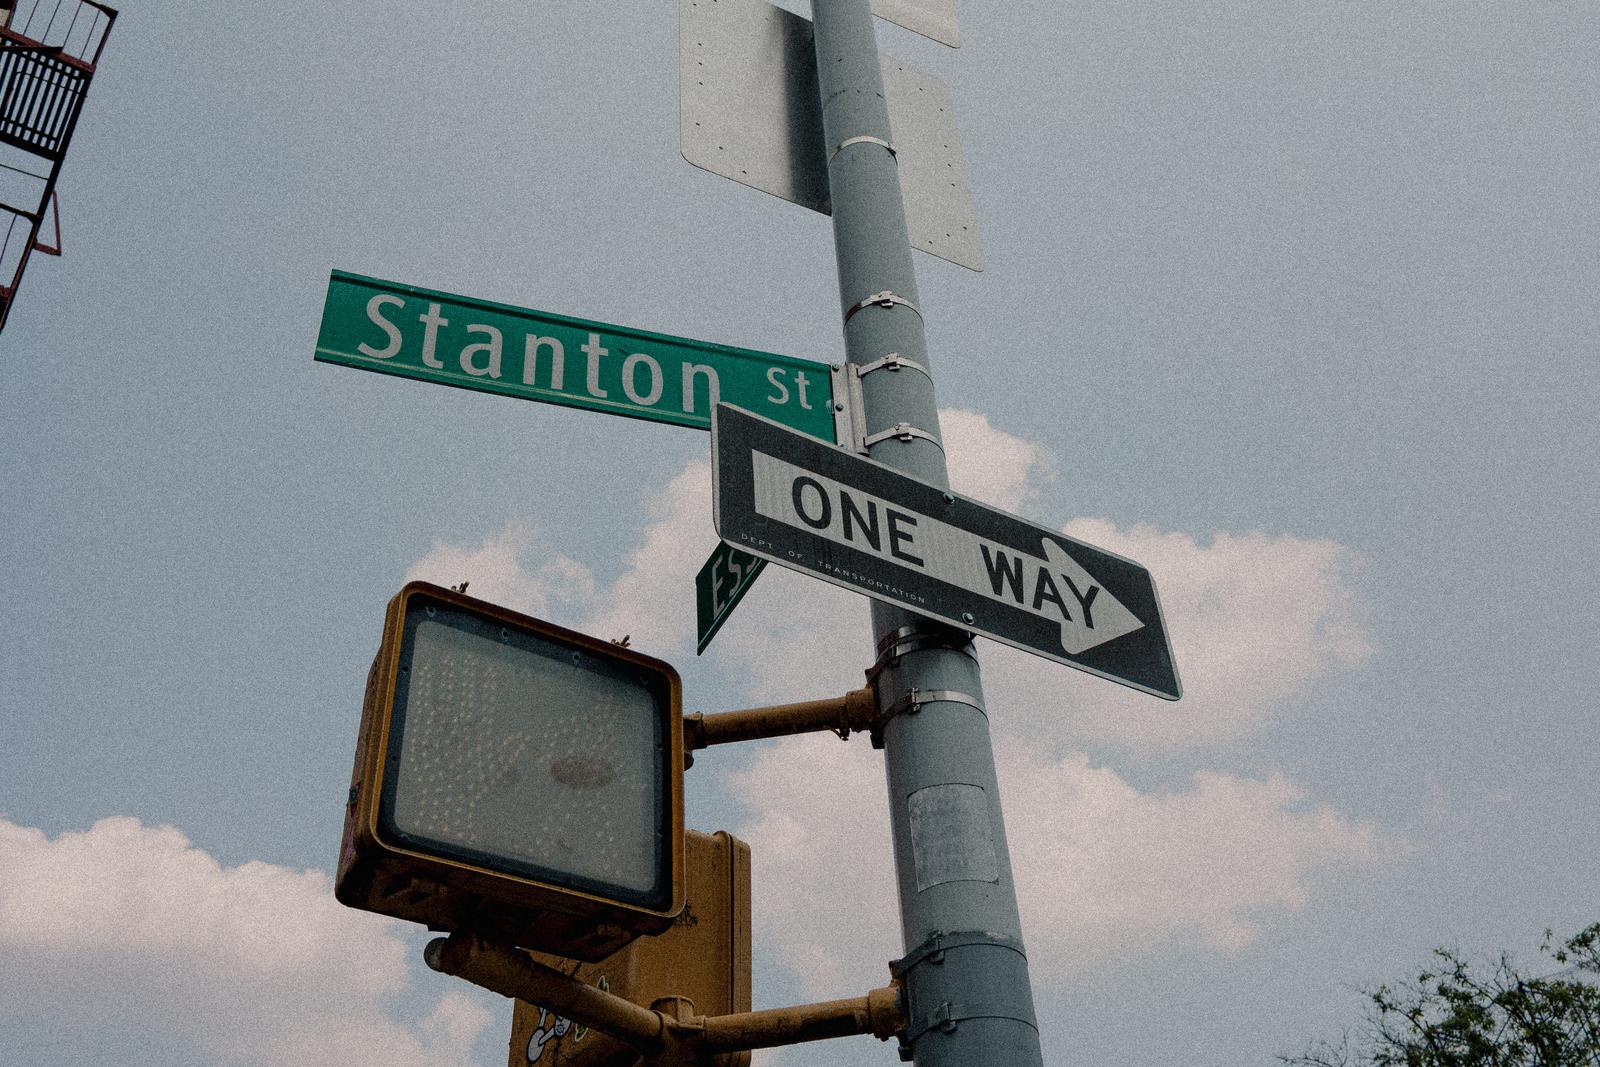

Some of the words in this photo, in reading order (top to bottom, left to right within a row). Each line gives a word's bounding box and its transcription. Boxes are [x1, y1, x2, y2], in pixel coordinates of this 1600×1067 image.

[358, 294, 721, 413] Stanton
[767, 367, 814, 410] St
[741, 533, 773, 549] DEPT
[788, 550, 803, 560] OF
[817, 560, 925, 603] TRANSPORTATION
[792, 475, 925, 568] ONE
[979, 544, 1100, 629] WAY
